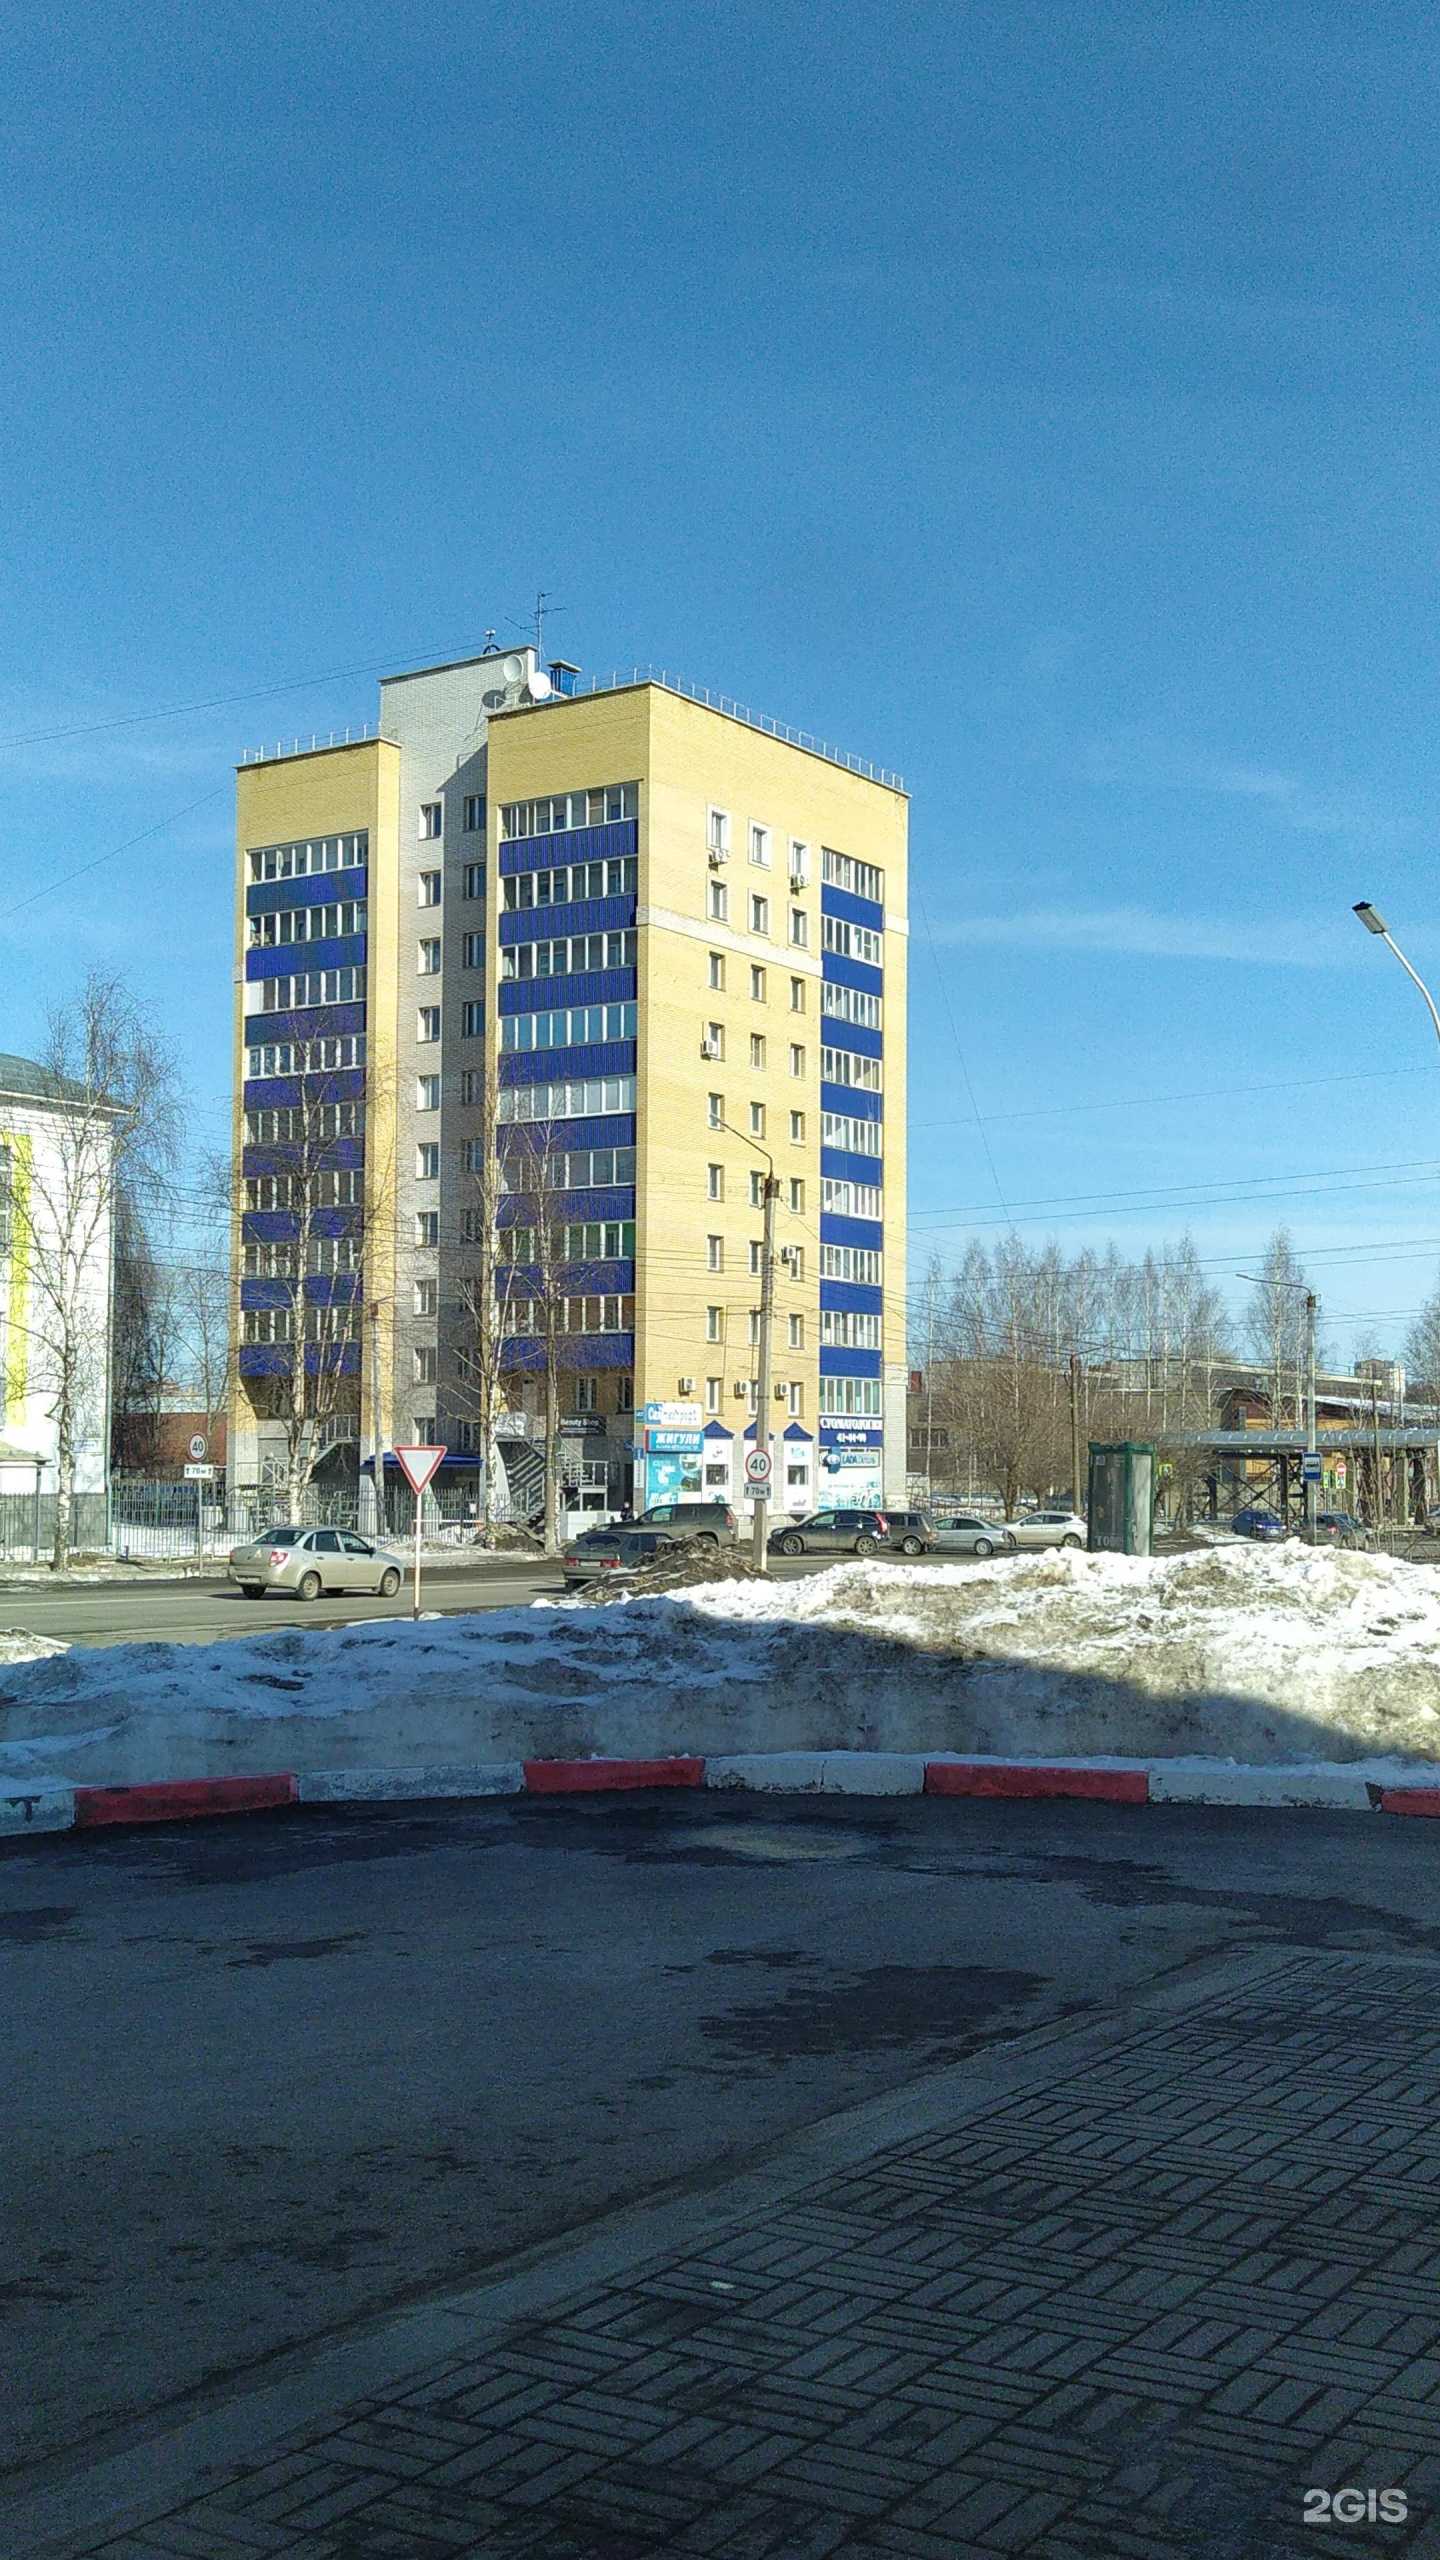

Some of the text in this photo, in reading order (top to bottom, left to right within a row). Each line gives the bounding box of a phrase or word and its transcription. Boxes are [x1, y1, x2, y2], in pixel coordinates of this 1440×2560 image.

[655, 1431, 701, 1444] ЖИГУЛИ
[192, 1440, 204, 1452] 40
[750, 1458, 767, 1472] 40
